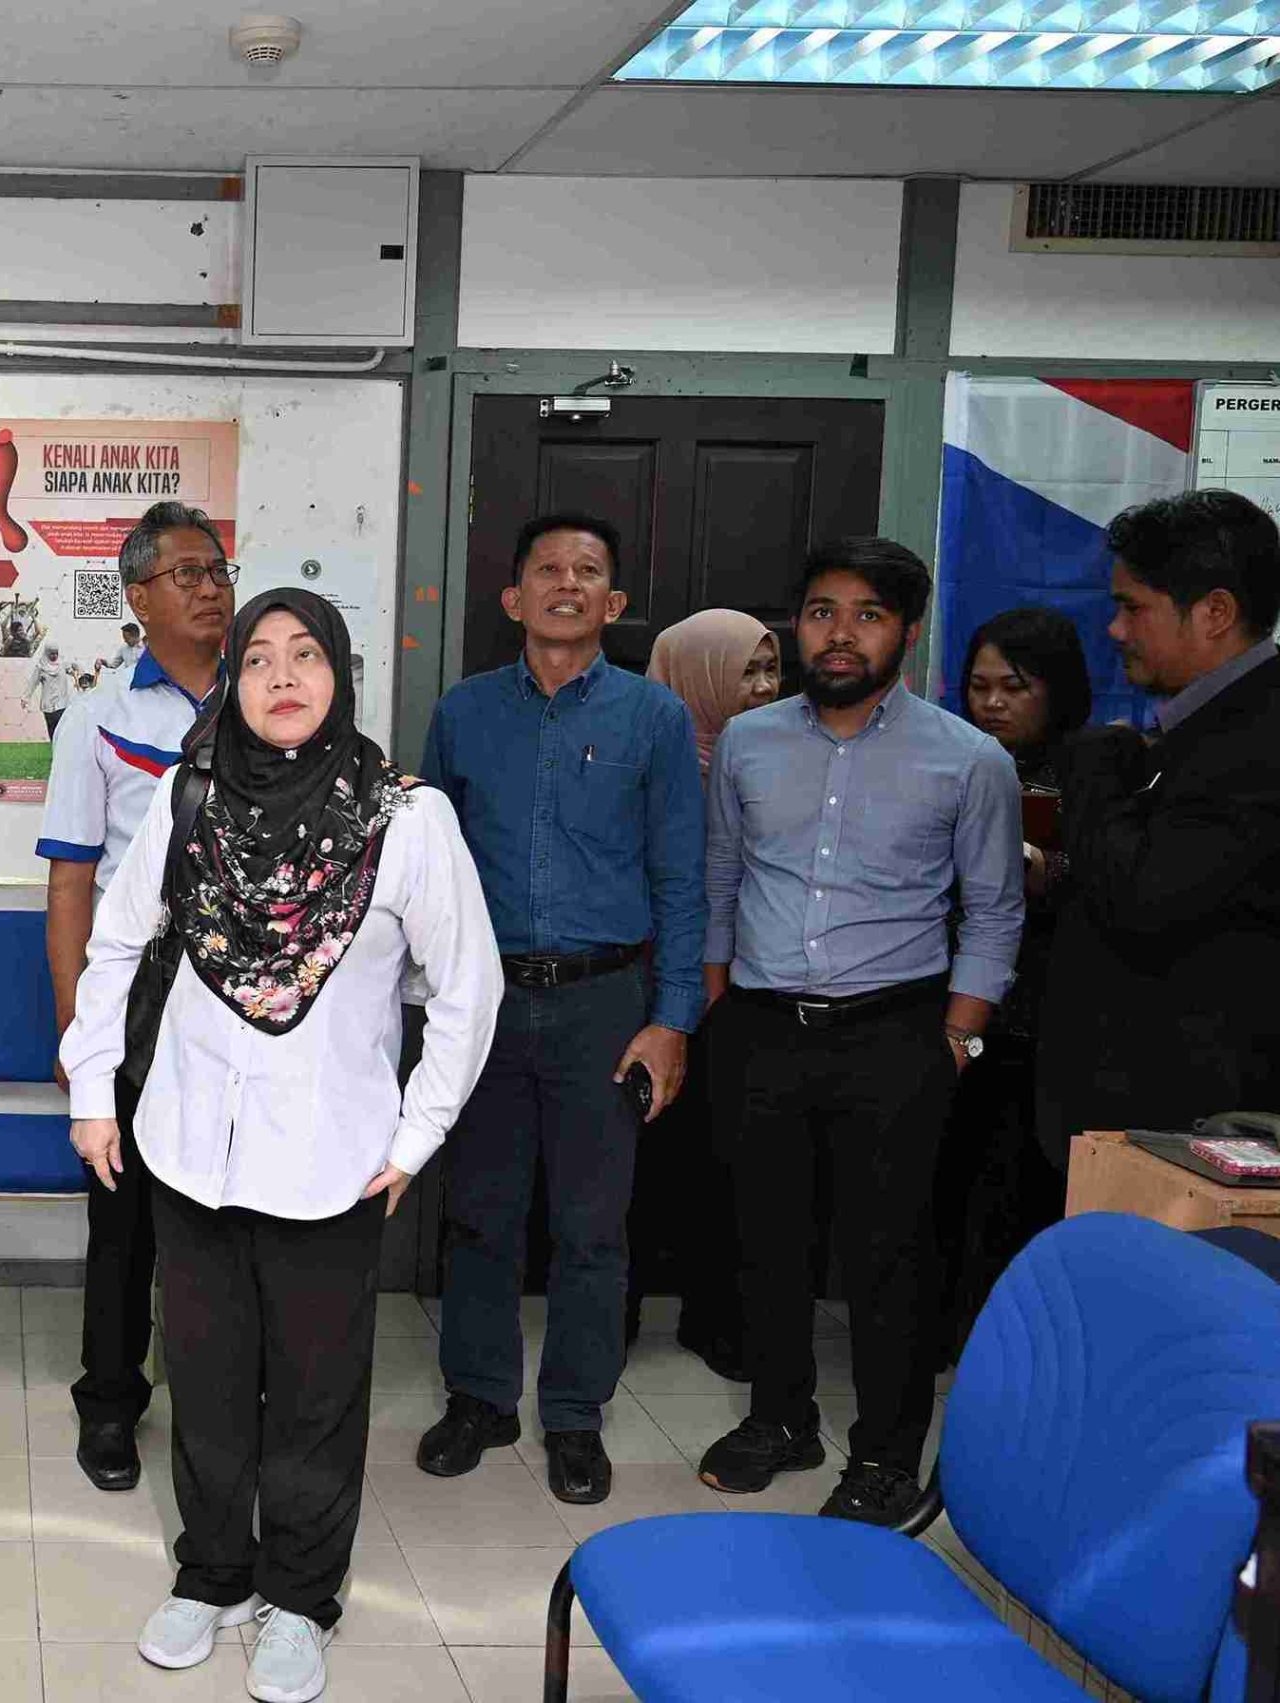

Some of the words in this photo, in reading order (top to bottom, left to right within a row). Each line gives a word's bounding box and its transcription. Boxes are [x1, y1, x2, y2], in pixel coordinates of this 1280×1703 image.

[43, 444, 96, 469] KENALI
[100, 445, 140, 469] ANAK
[145, 446, 180, 470] KITA
[44, 471, 87, 493] SIAPA
[93, 472, 132, 493] ANAK
[137, 472, 180, 495] KITA?
